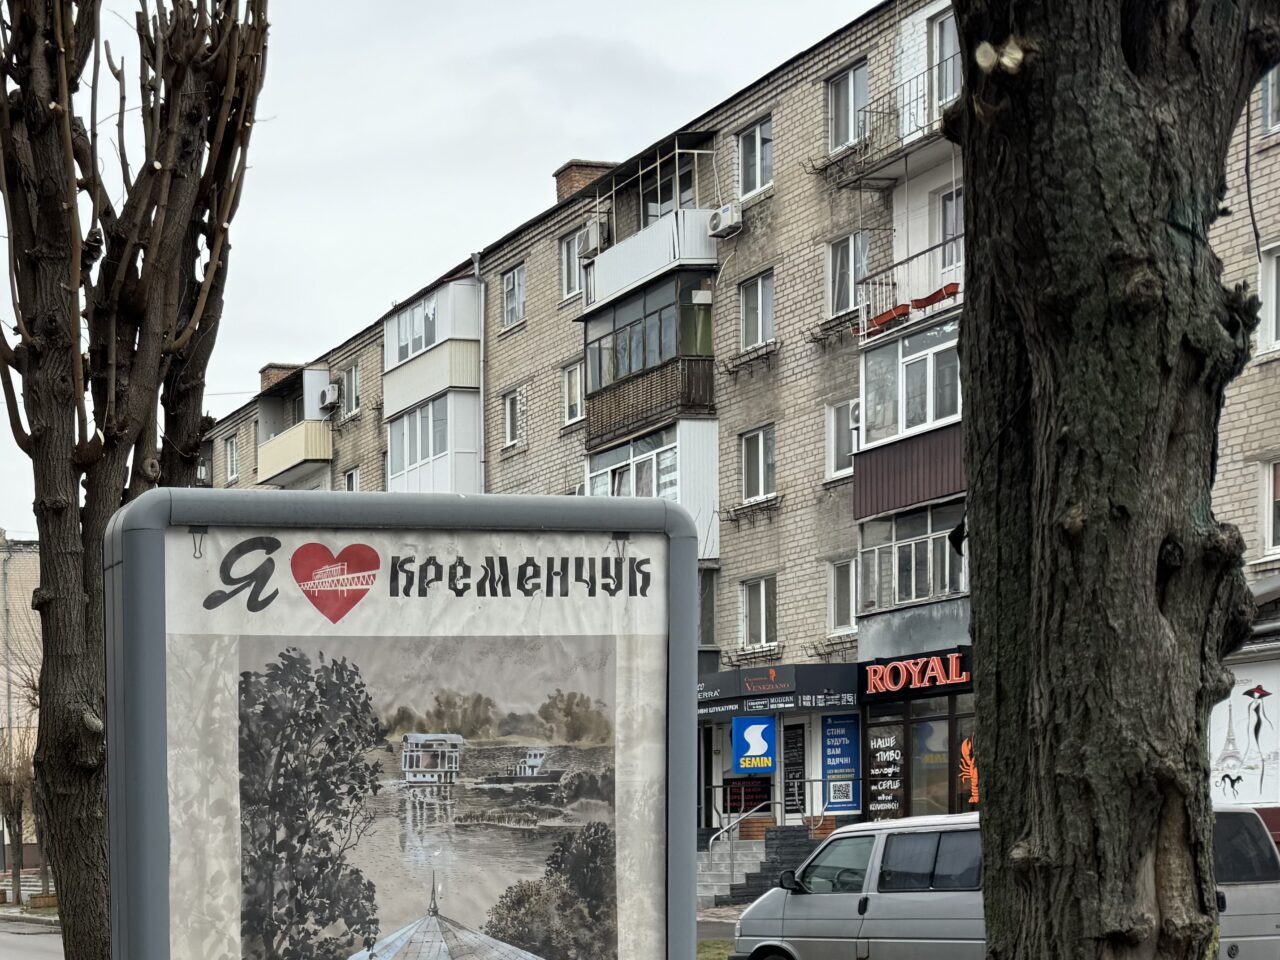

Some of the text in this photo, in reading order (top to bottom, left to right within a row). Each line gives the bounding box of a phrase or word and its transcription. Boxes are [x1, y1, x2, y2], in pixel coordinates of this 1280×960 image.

[203, 536, 281, 612] Я
[866, 653, 970, 694] ROYAL
[870, 735, 896, 749] НАШЕ
[826, 747, 841, 756] ВАМ
[875, 750, 901, 762] ПИВО
[740, 756, 772, 768] SEMIN
